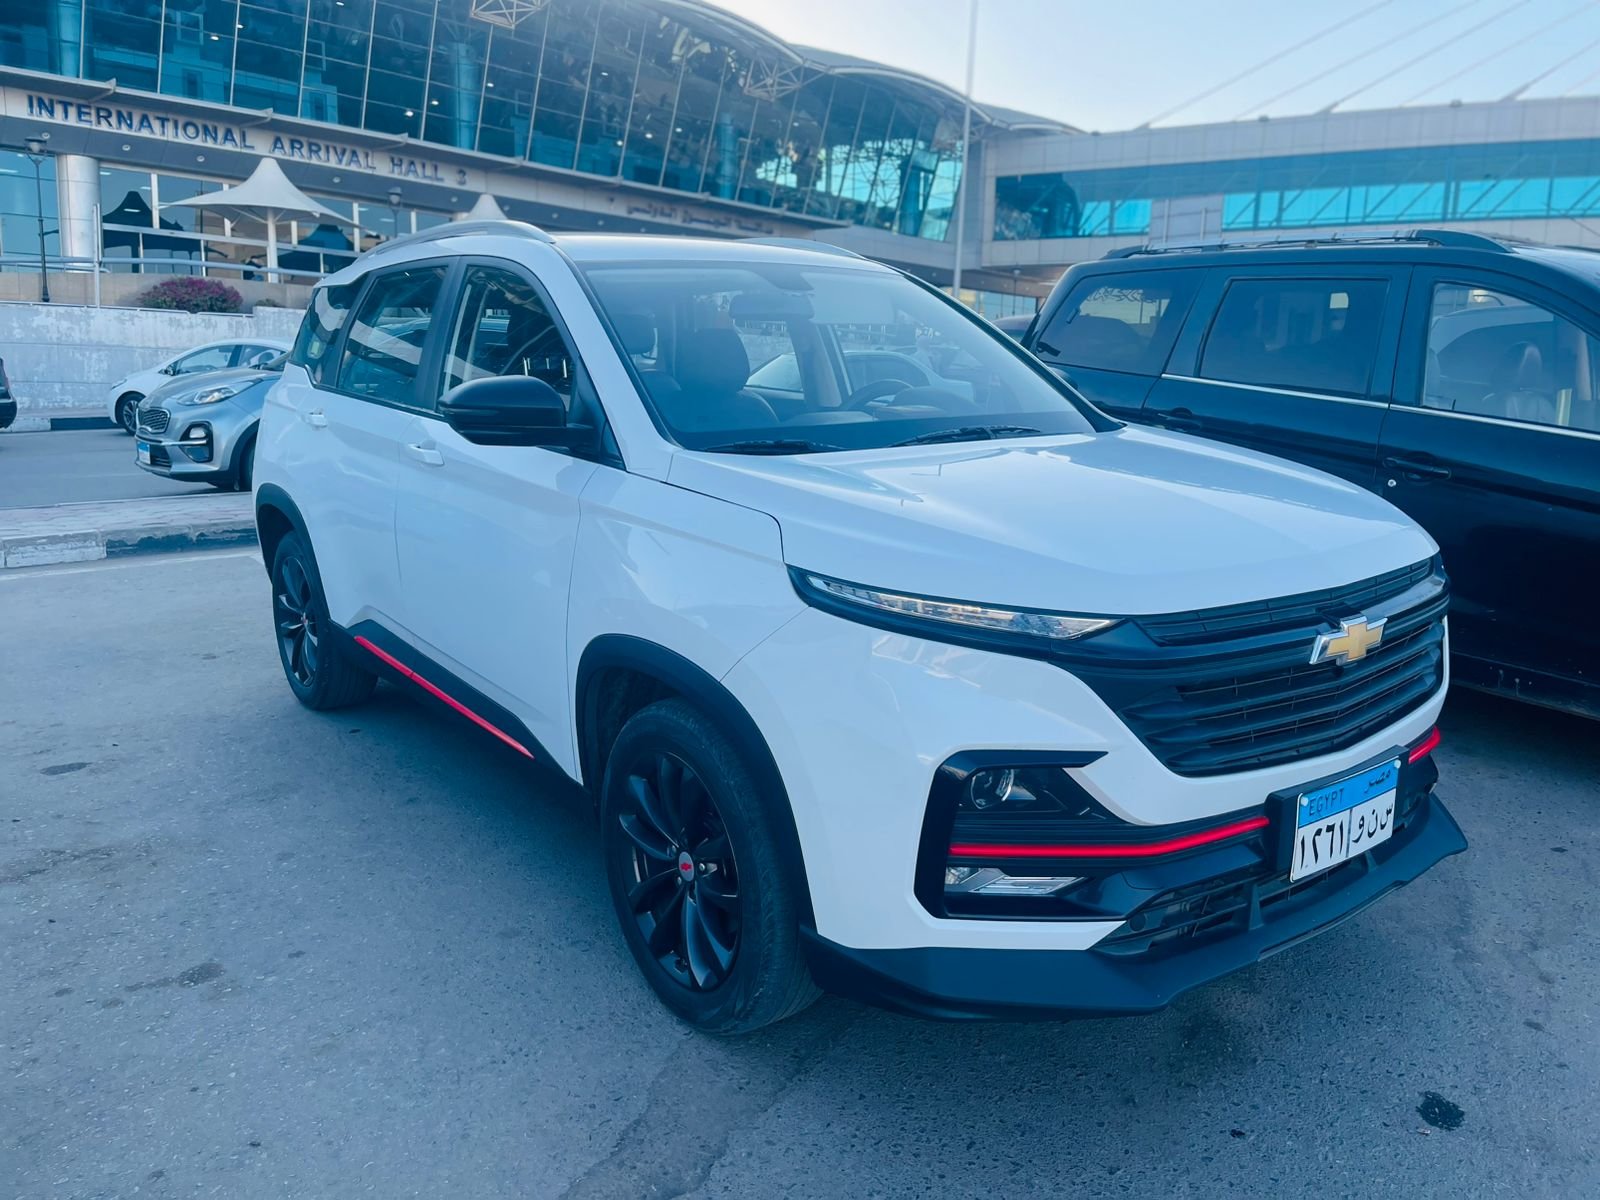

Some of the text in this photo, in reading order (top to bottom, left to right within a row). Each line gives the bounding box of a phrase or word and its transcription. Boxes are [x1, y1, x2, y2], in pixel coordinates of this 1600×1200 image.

[27, 94, 255, 149] INTERNATIONAL
[272, 135, 376, 170] ARRIVAL
[390, 156, 444, 182] HALL
[1364, 769, 1391, 794] مصر
[1309, 787, 1344, 817] EGYPT
